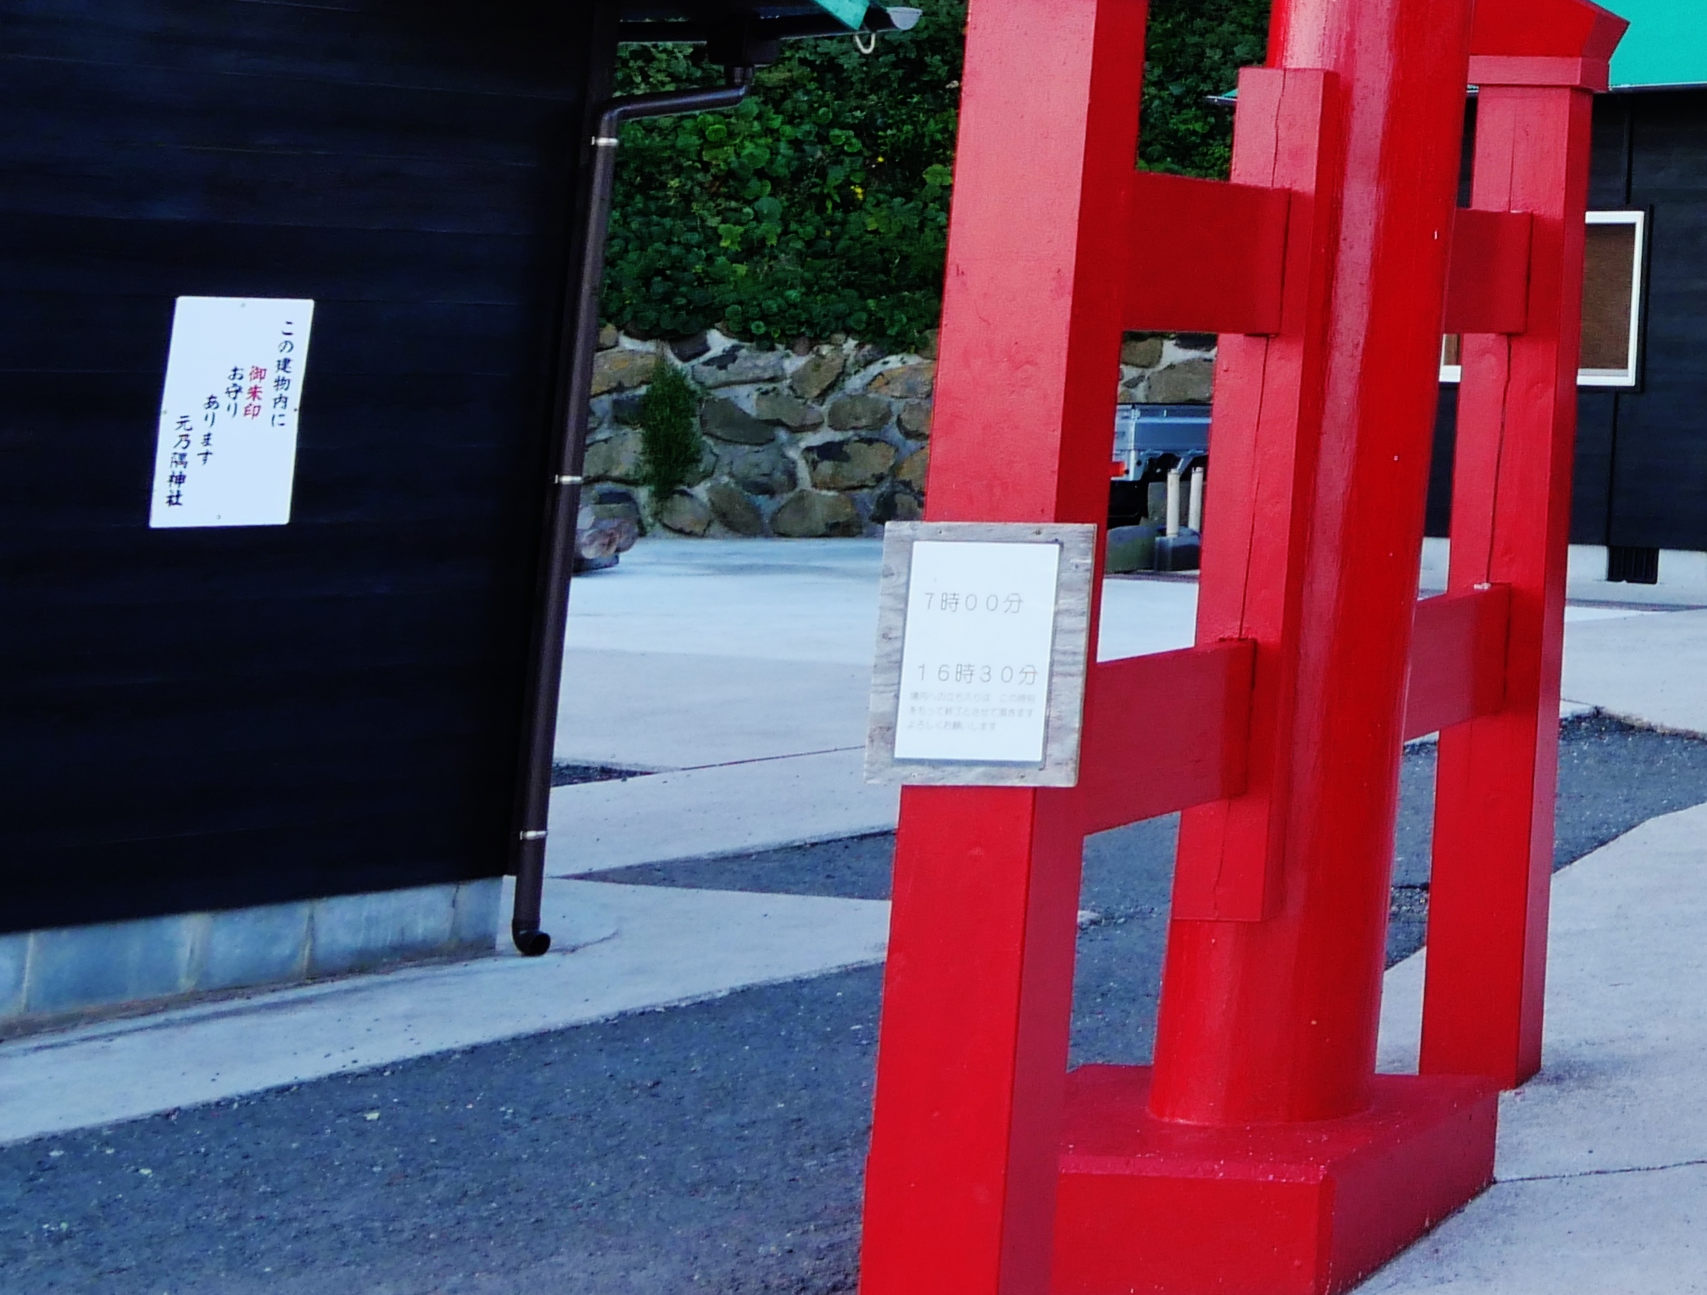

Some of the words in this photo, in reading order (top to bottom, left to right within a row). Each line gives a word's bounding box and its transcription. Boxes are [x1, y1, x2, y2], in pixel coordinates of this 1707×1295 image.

[225, 365, 245, 419] お守り
[243, 365, 267, 420] 御朱印
[270, 320, 295, 428] この建物内に
[165, 415, 193, 507] 元乃隅神社
[197, 393, 220, 467] あります
